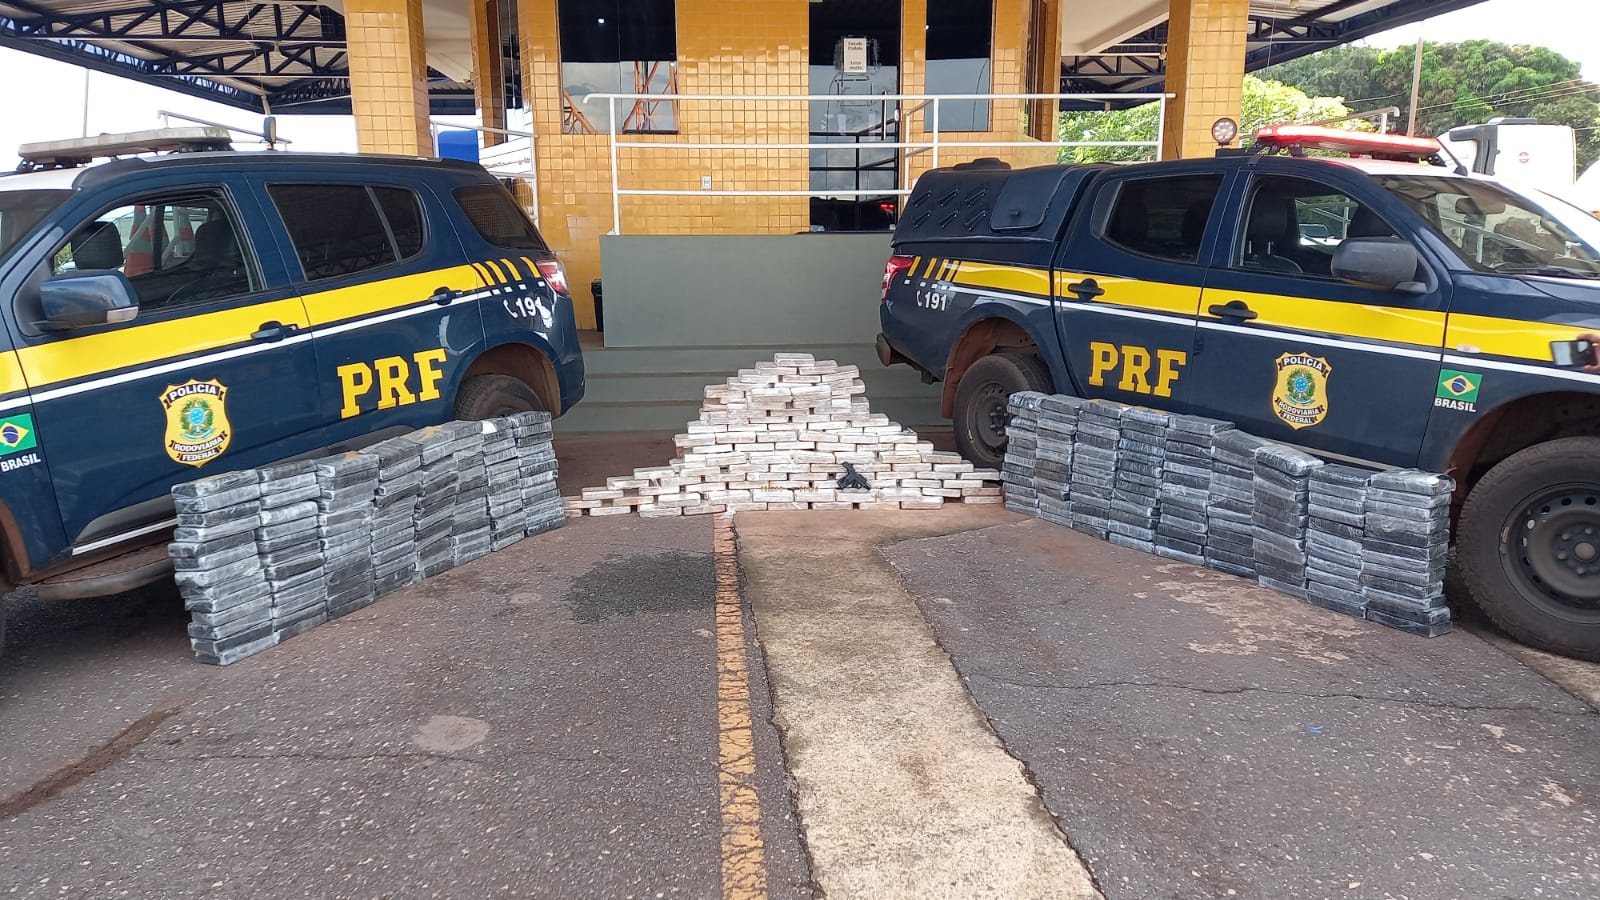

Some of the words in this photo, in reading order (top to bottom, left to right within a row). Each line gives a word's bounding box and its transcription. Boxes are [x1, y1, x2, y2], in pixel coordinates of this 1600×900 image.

[924, 291, 947, 312] 191
[1088, 341, 1187, 398] PRF
[336, 348, 447, 419] PRF
[1434, 397, 1477, 413] BRASIL
[1283, 413, 1313, 424] FEDERAL
[1, 453, 41, 473] BRASIL
[182, 449, 217, 461] FEDERAL
